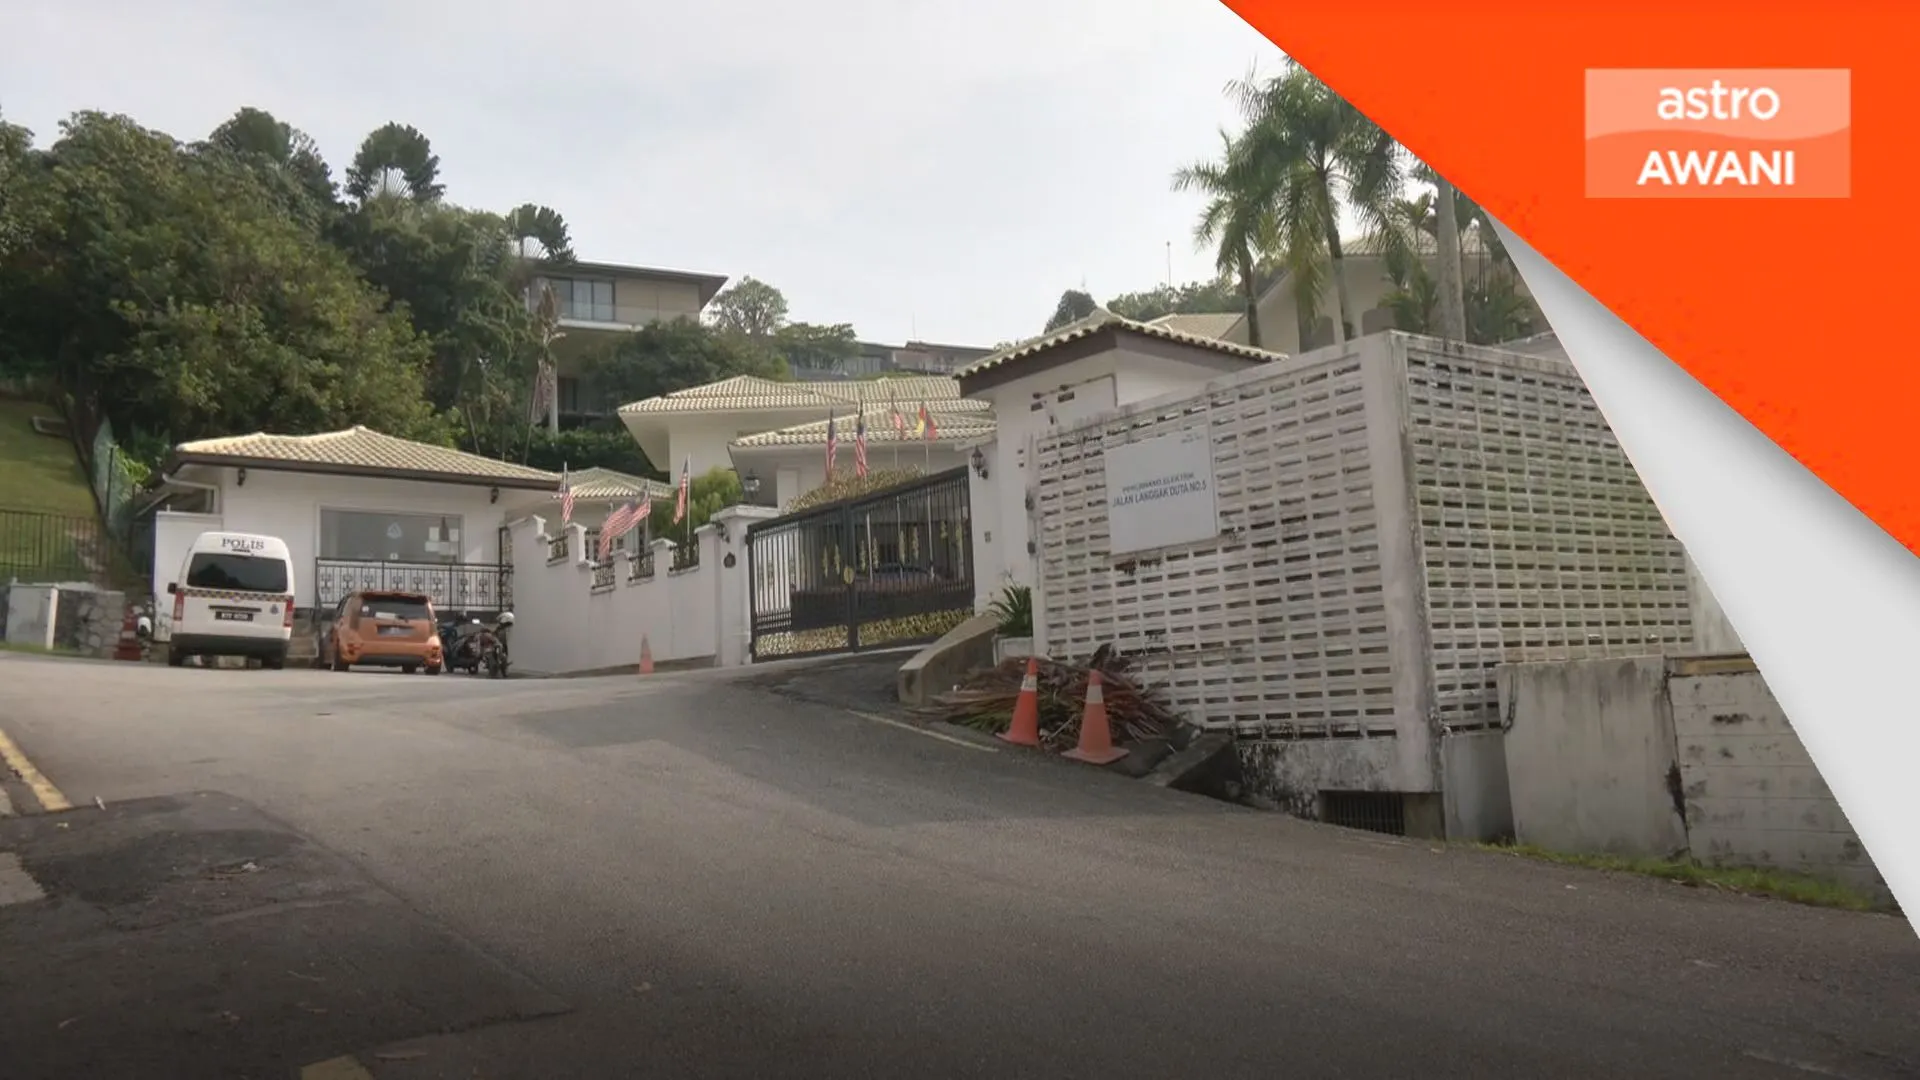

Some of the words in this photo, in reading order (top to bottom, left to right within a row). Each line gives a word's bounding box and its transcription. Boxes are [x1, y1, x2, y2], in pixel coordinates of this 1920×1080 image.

[1112, 494, 1134, 507] JALAN
[1135, 488, 1168, 503] LANGGAK
[1169, 483, 1189, 496] DUTA
[221, 538, 265, 550] POLIS
